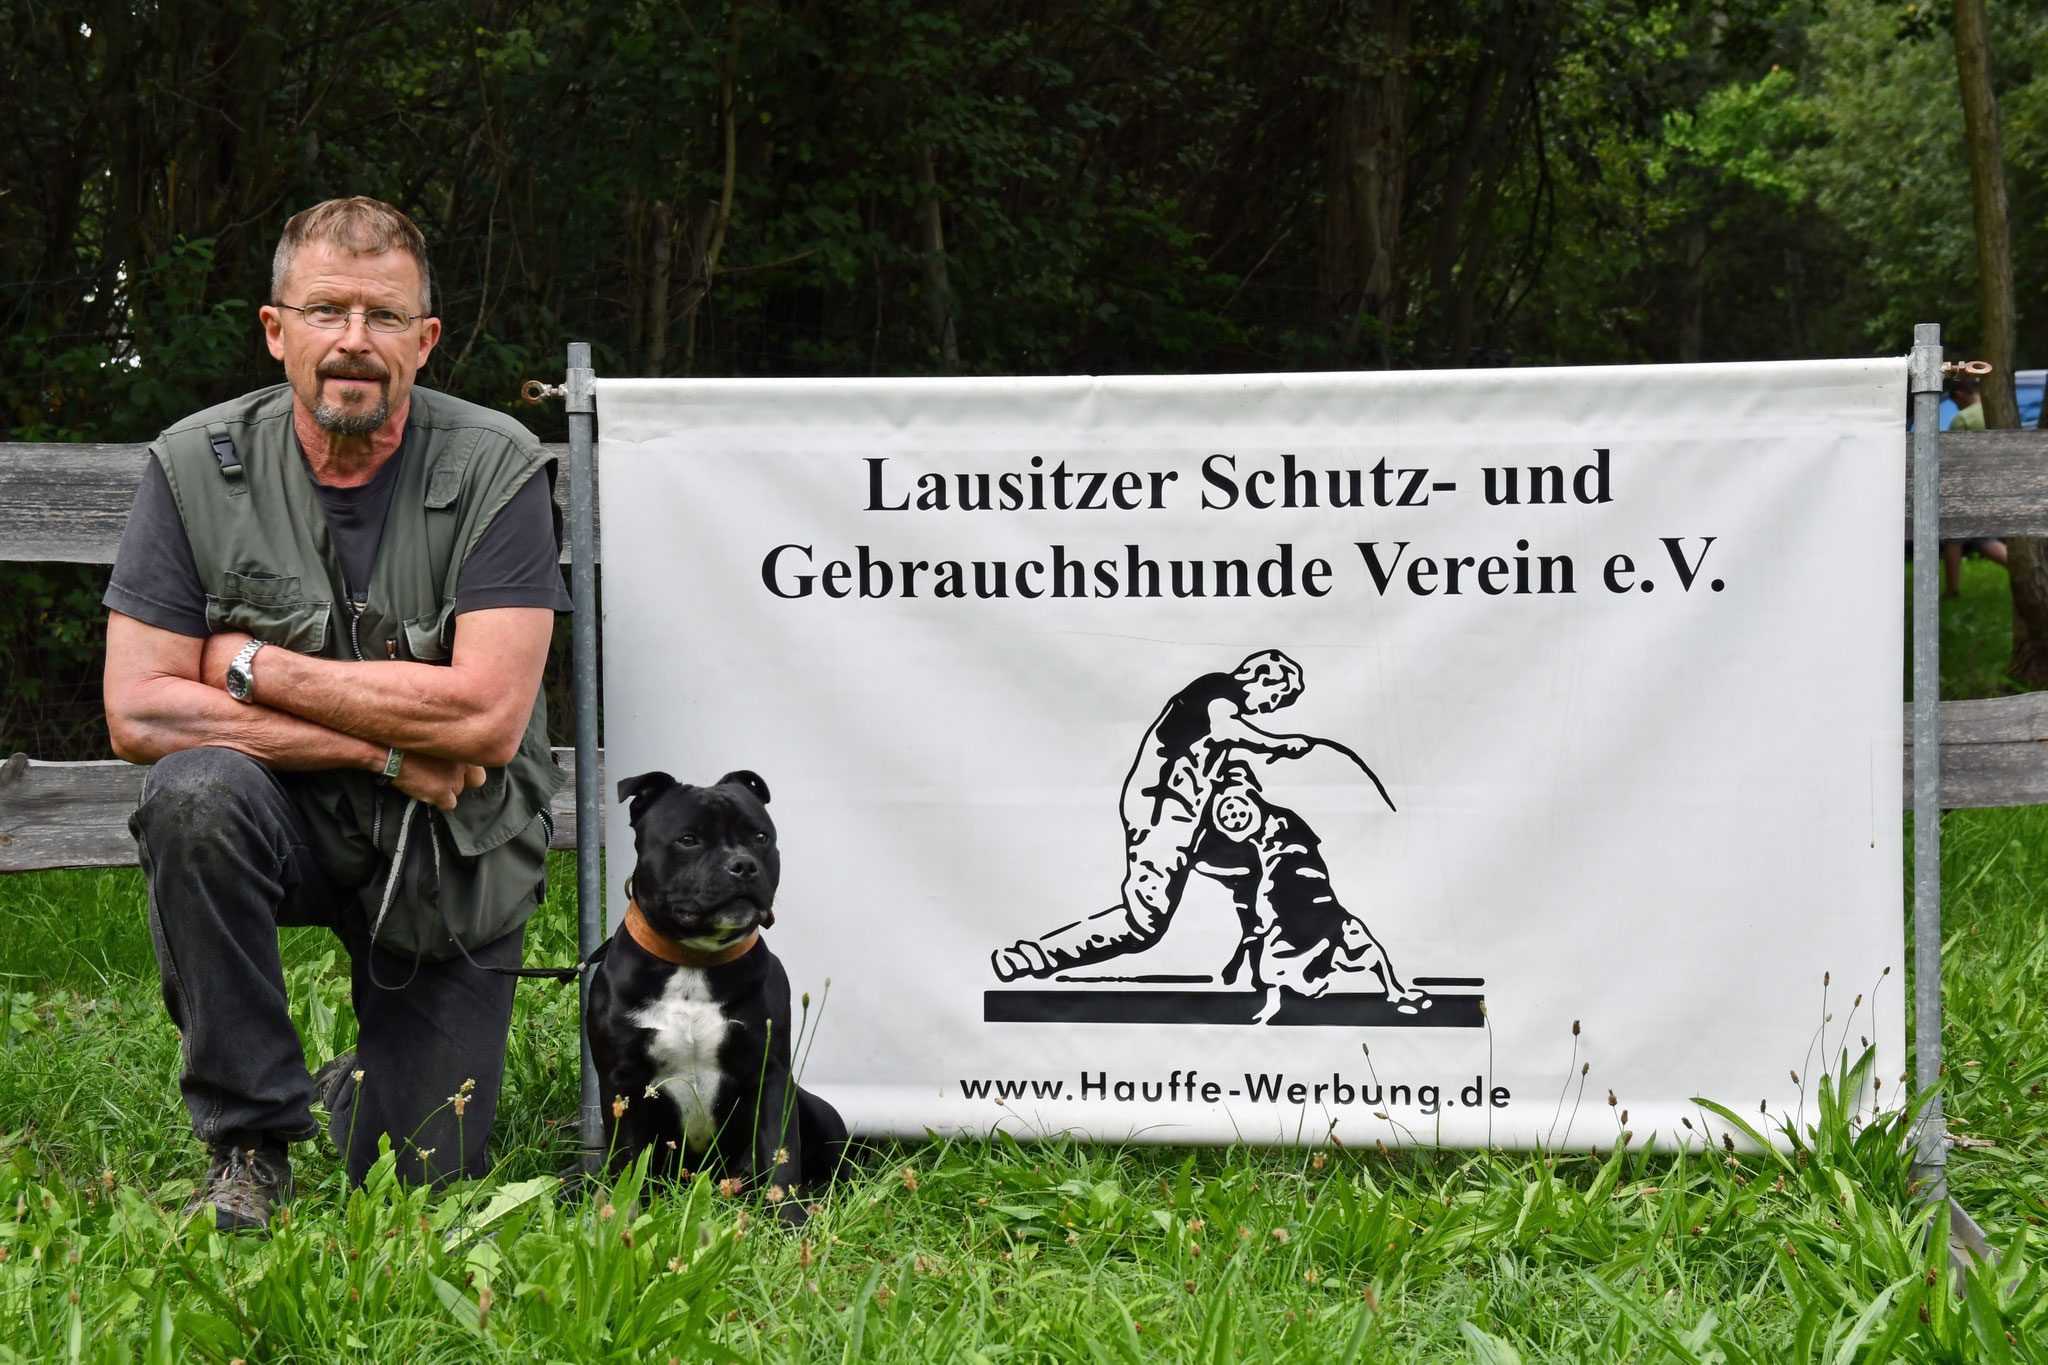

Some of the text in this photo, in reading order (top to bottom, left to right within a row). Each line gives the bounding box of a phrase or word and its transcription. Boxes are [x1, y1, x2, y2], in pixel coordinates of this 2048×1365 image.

[864, 449, 1614, 511] Lausitzer Schutz- und
[761, 536, 1725, 599] Gebrauchshunde Verein e.V.
[960, 1071, 1511, 1114] www.Hauffe-Werbung.de
